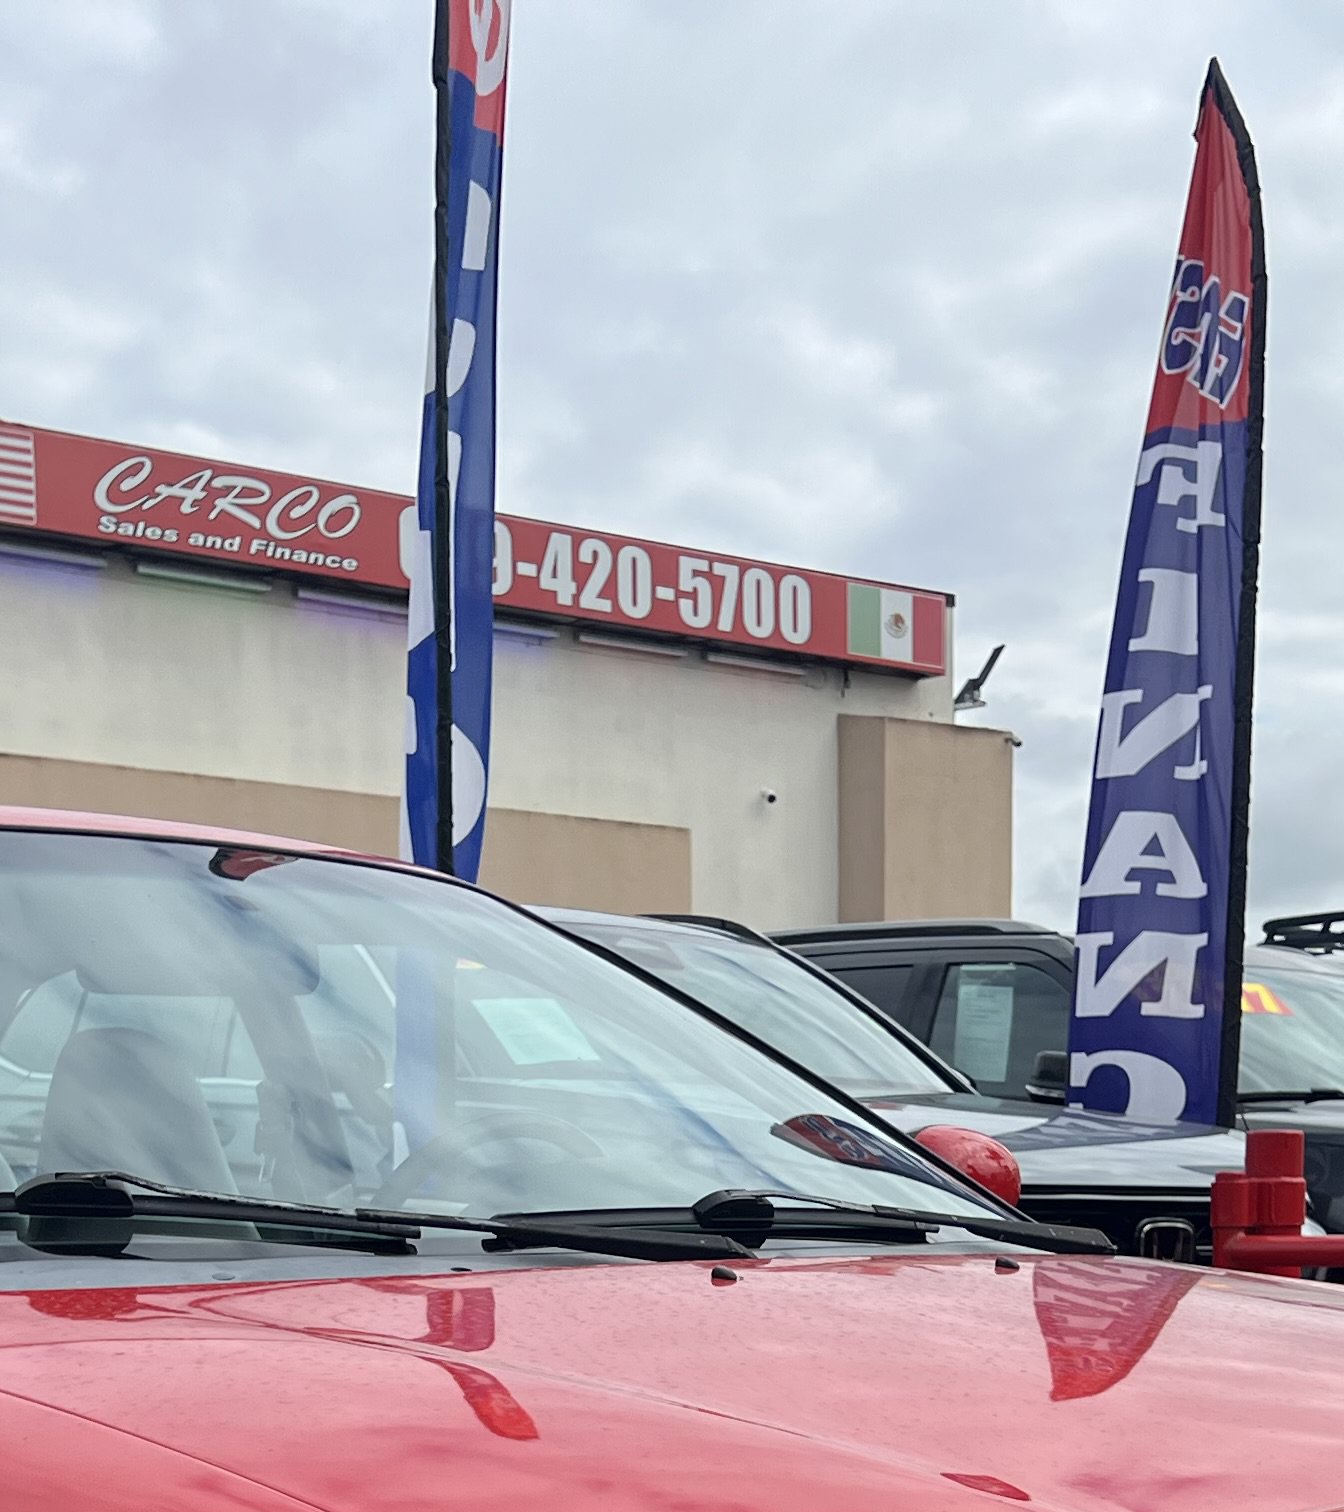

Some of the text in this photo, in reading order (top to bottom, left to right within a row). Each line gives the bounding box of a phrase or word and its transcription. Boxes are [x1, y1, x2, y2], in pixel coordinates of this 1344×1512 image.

[94, 456, 361, 540] CARCO
[97, 514, 360, 572] Sales and Finance
